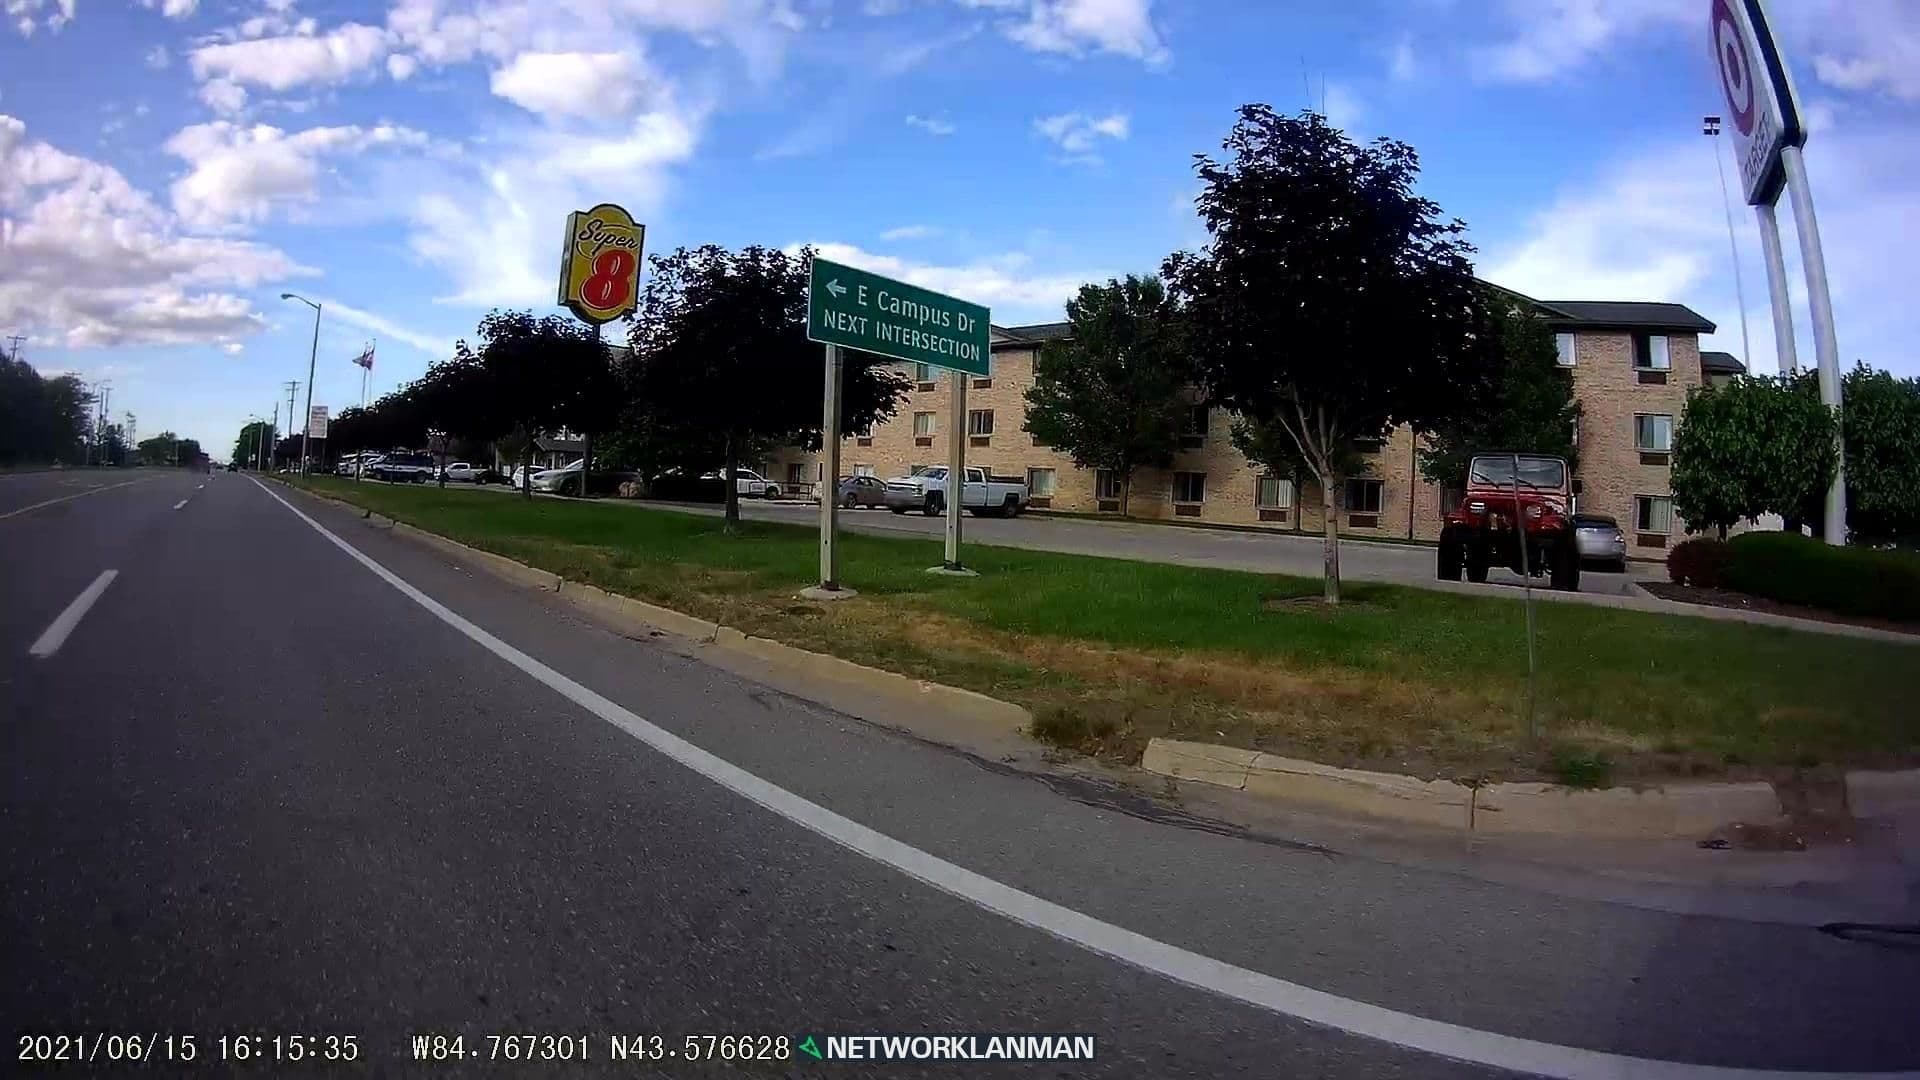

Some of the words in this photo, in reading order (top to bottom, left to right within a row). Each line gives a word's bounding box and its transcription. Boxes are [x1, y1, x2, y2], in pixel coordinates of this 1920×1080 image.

[578, 218, 638, 256] Super
[579, 247, 636, 311] 8
[858, 285, 868, 306] E
[878, 291, 950, 327] Campus
[958, 312, 976, 334] Dr
[824, 309, 868, 336] NEXT
[876, 321, 980, 361] INTERSECTION
